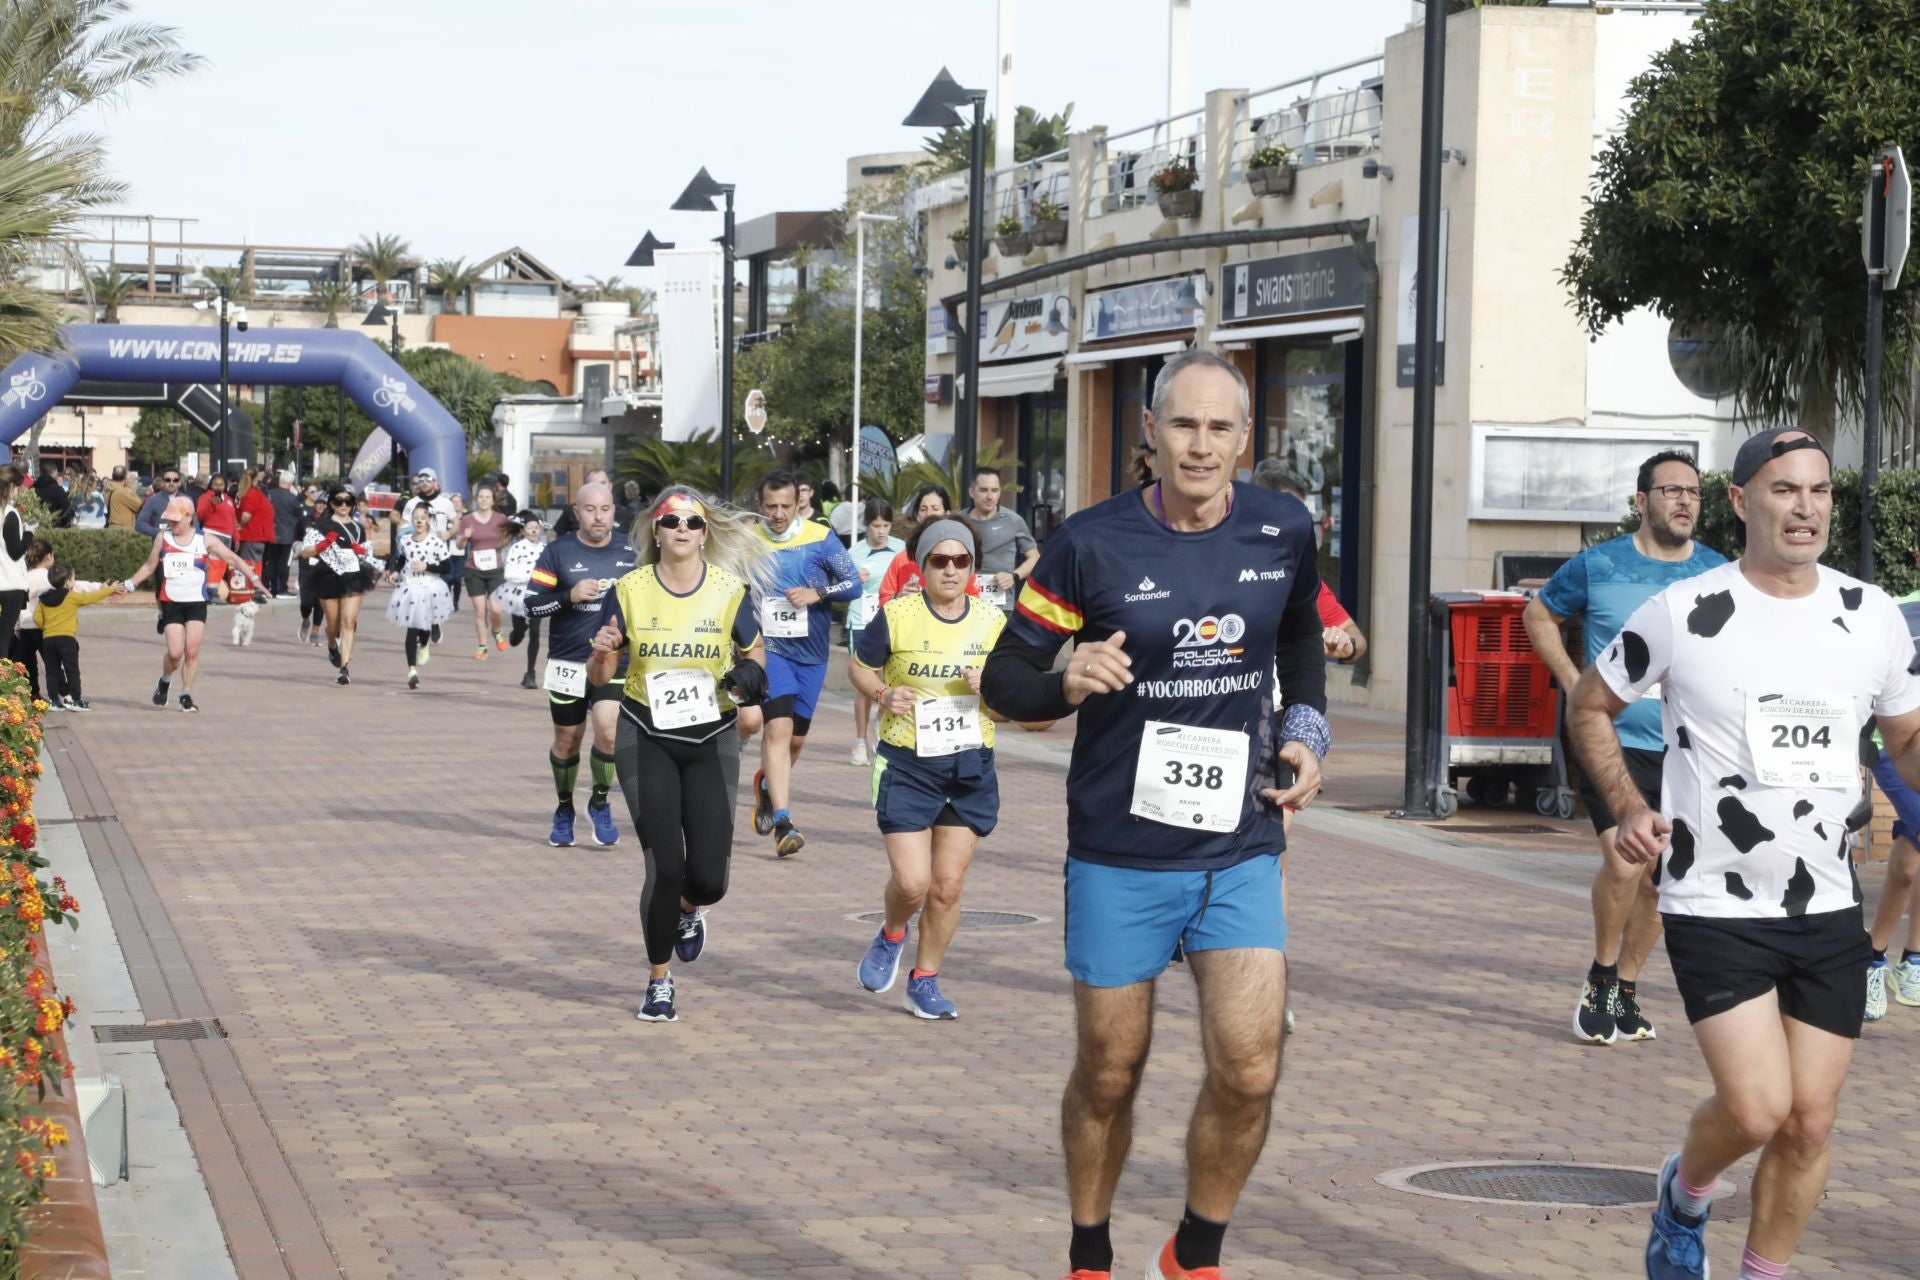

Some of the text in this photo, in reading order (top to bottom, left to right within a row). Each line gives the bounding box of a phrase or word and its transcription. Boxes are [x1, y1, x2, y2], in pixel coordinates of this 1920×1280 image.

[109, 339, 303, 363] WWW.CONCHIP.ES
[981, 584, 999, 593] 152
[1124, 590, 1172, 602] Santander
[772, 611, 797, 622] 154
[1172, 613, 1246, 649] 200
[1173, 648, 1230, 660] POLICIA
[1173, 655, 1242, 668] NACIONAL
[556, 666, 578, 679] 157
[664, 685, 699, 705] 241
[932, 716, 964, 732] 131
[1771, 724, 1831, 748] 204
[1163, 760, 1223, 790] 338
